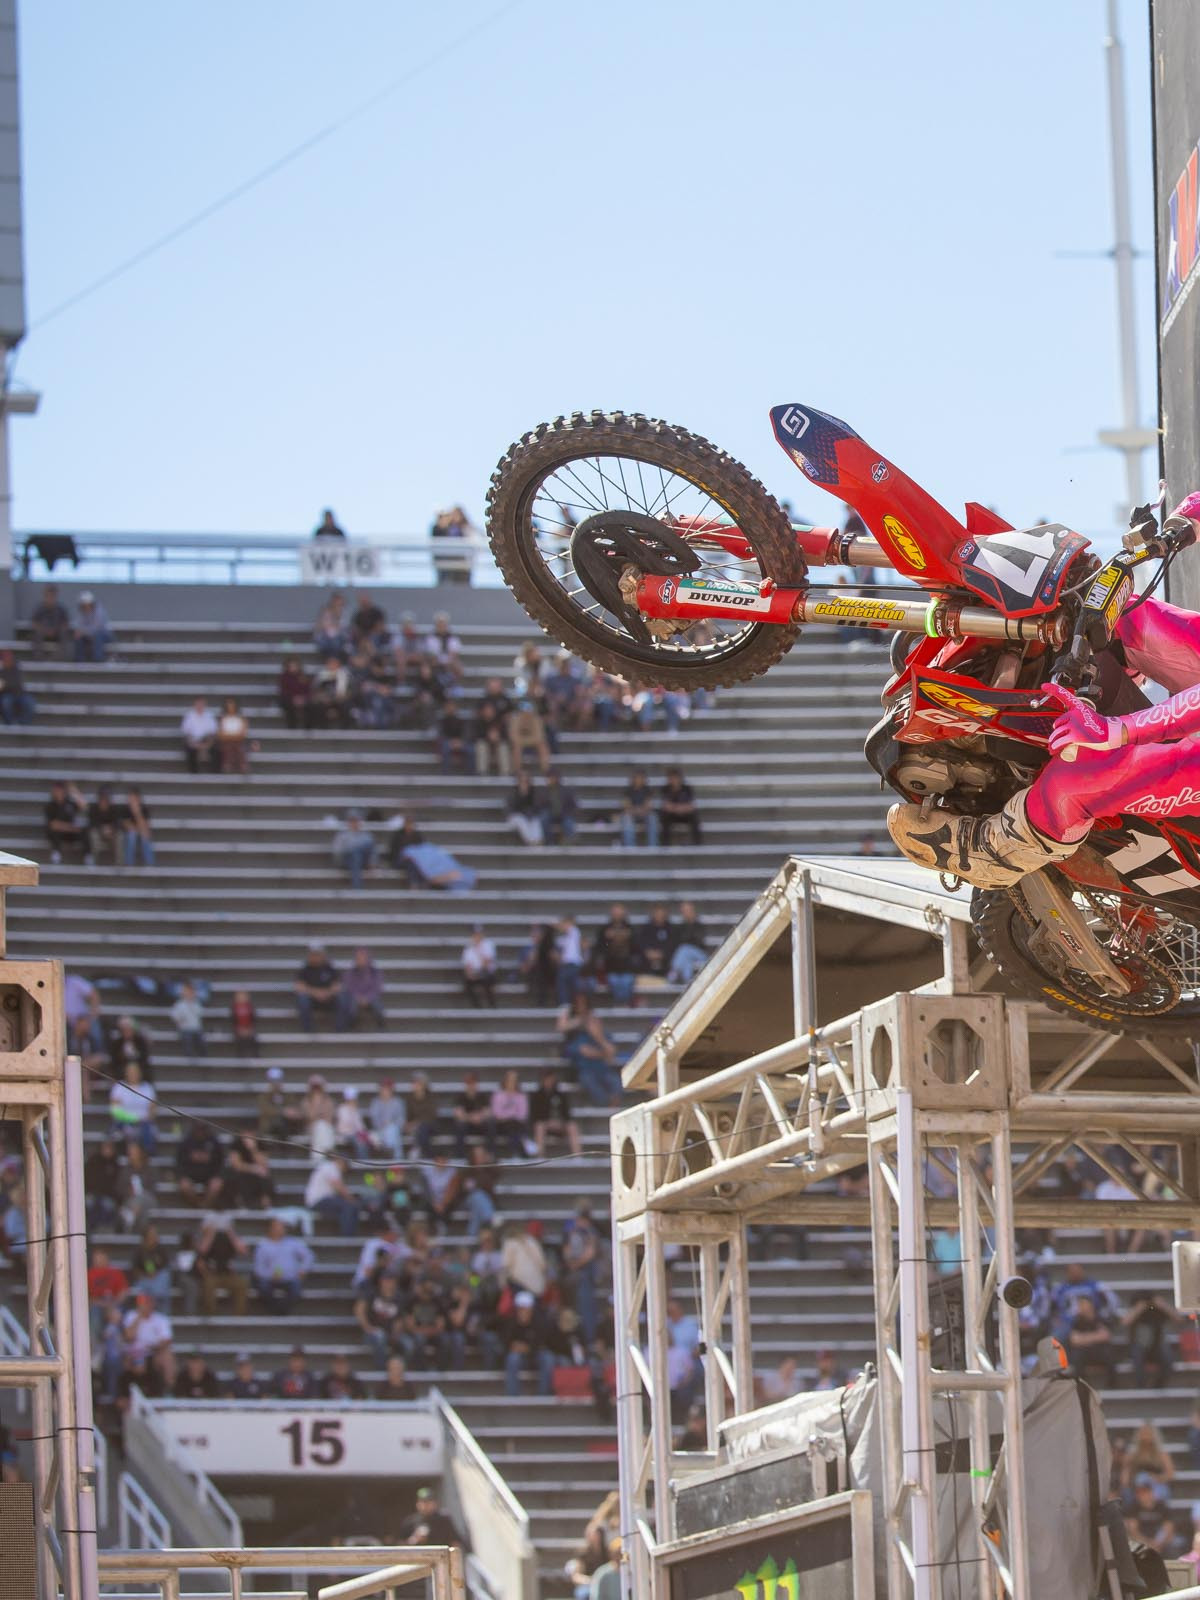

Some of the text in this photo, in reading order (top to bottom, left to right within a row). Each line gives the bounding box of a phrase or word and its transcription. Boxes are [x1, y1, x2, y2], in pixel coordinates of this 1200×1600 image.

[882, 514, 927, 570] FMF
[687, 591, 755, 606] DUNLOP
[814, 602, 906, 621] Connection
[1124, 794, 1177, 815] Troy
[280, 1420, 346, 1467] 15
